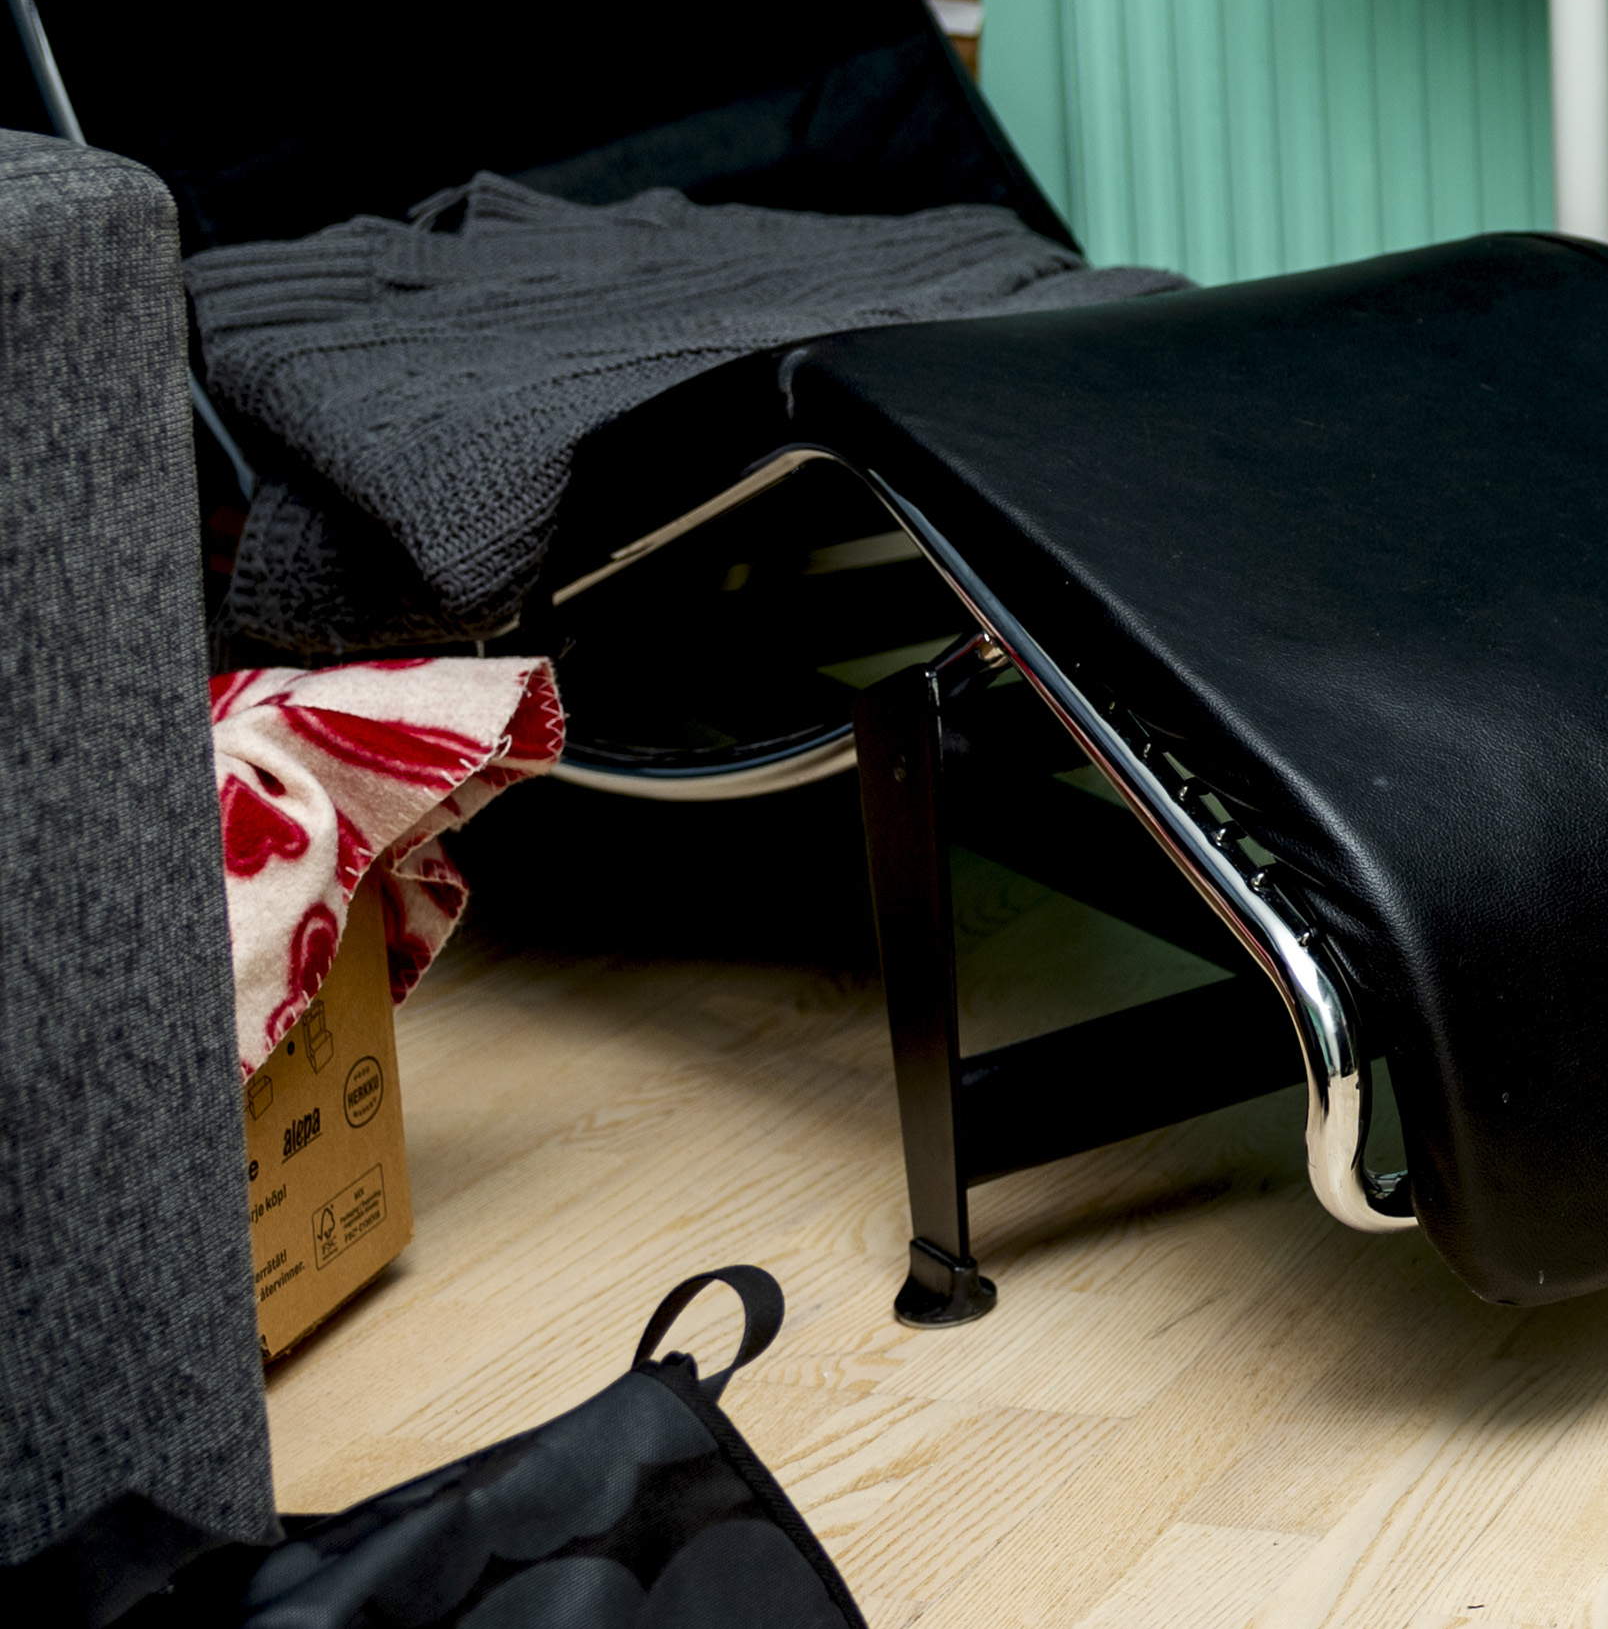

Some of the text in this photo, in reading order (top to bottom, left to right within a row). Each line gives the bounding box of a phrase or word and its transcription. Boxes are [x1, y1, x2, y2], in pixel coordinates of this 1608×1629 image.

[347, 1073, 380, 1109] HERKKU
[283, 1107, 321, 1157] alepa
[250, 1204, 264, 1224] rje
